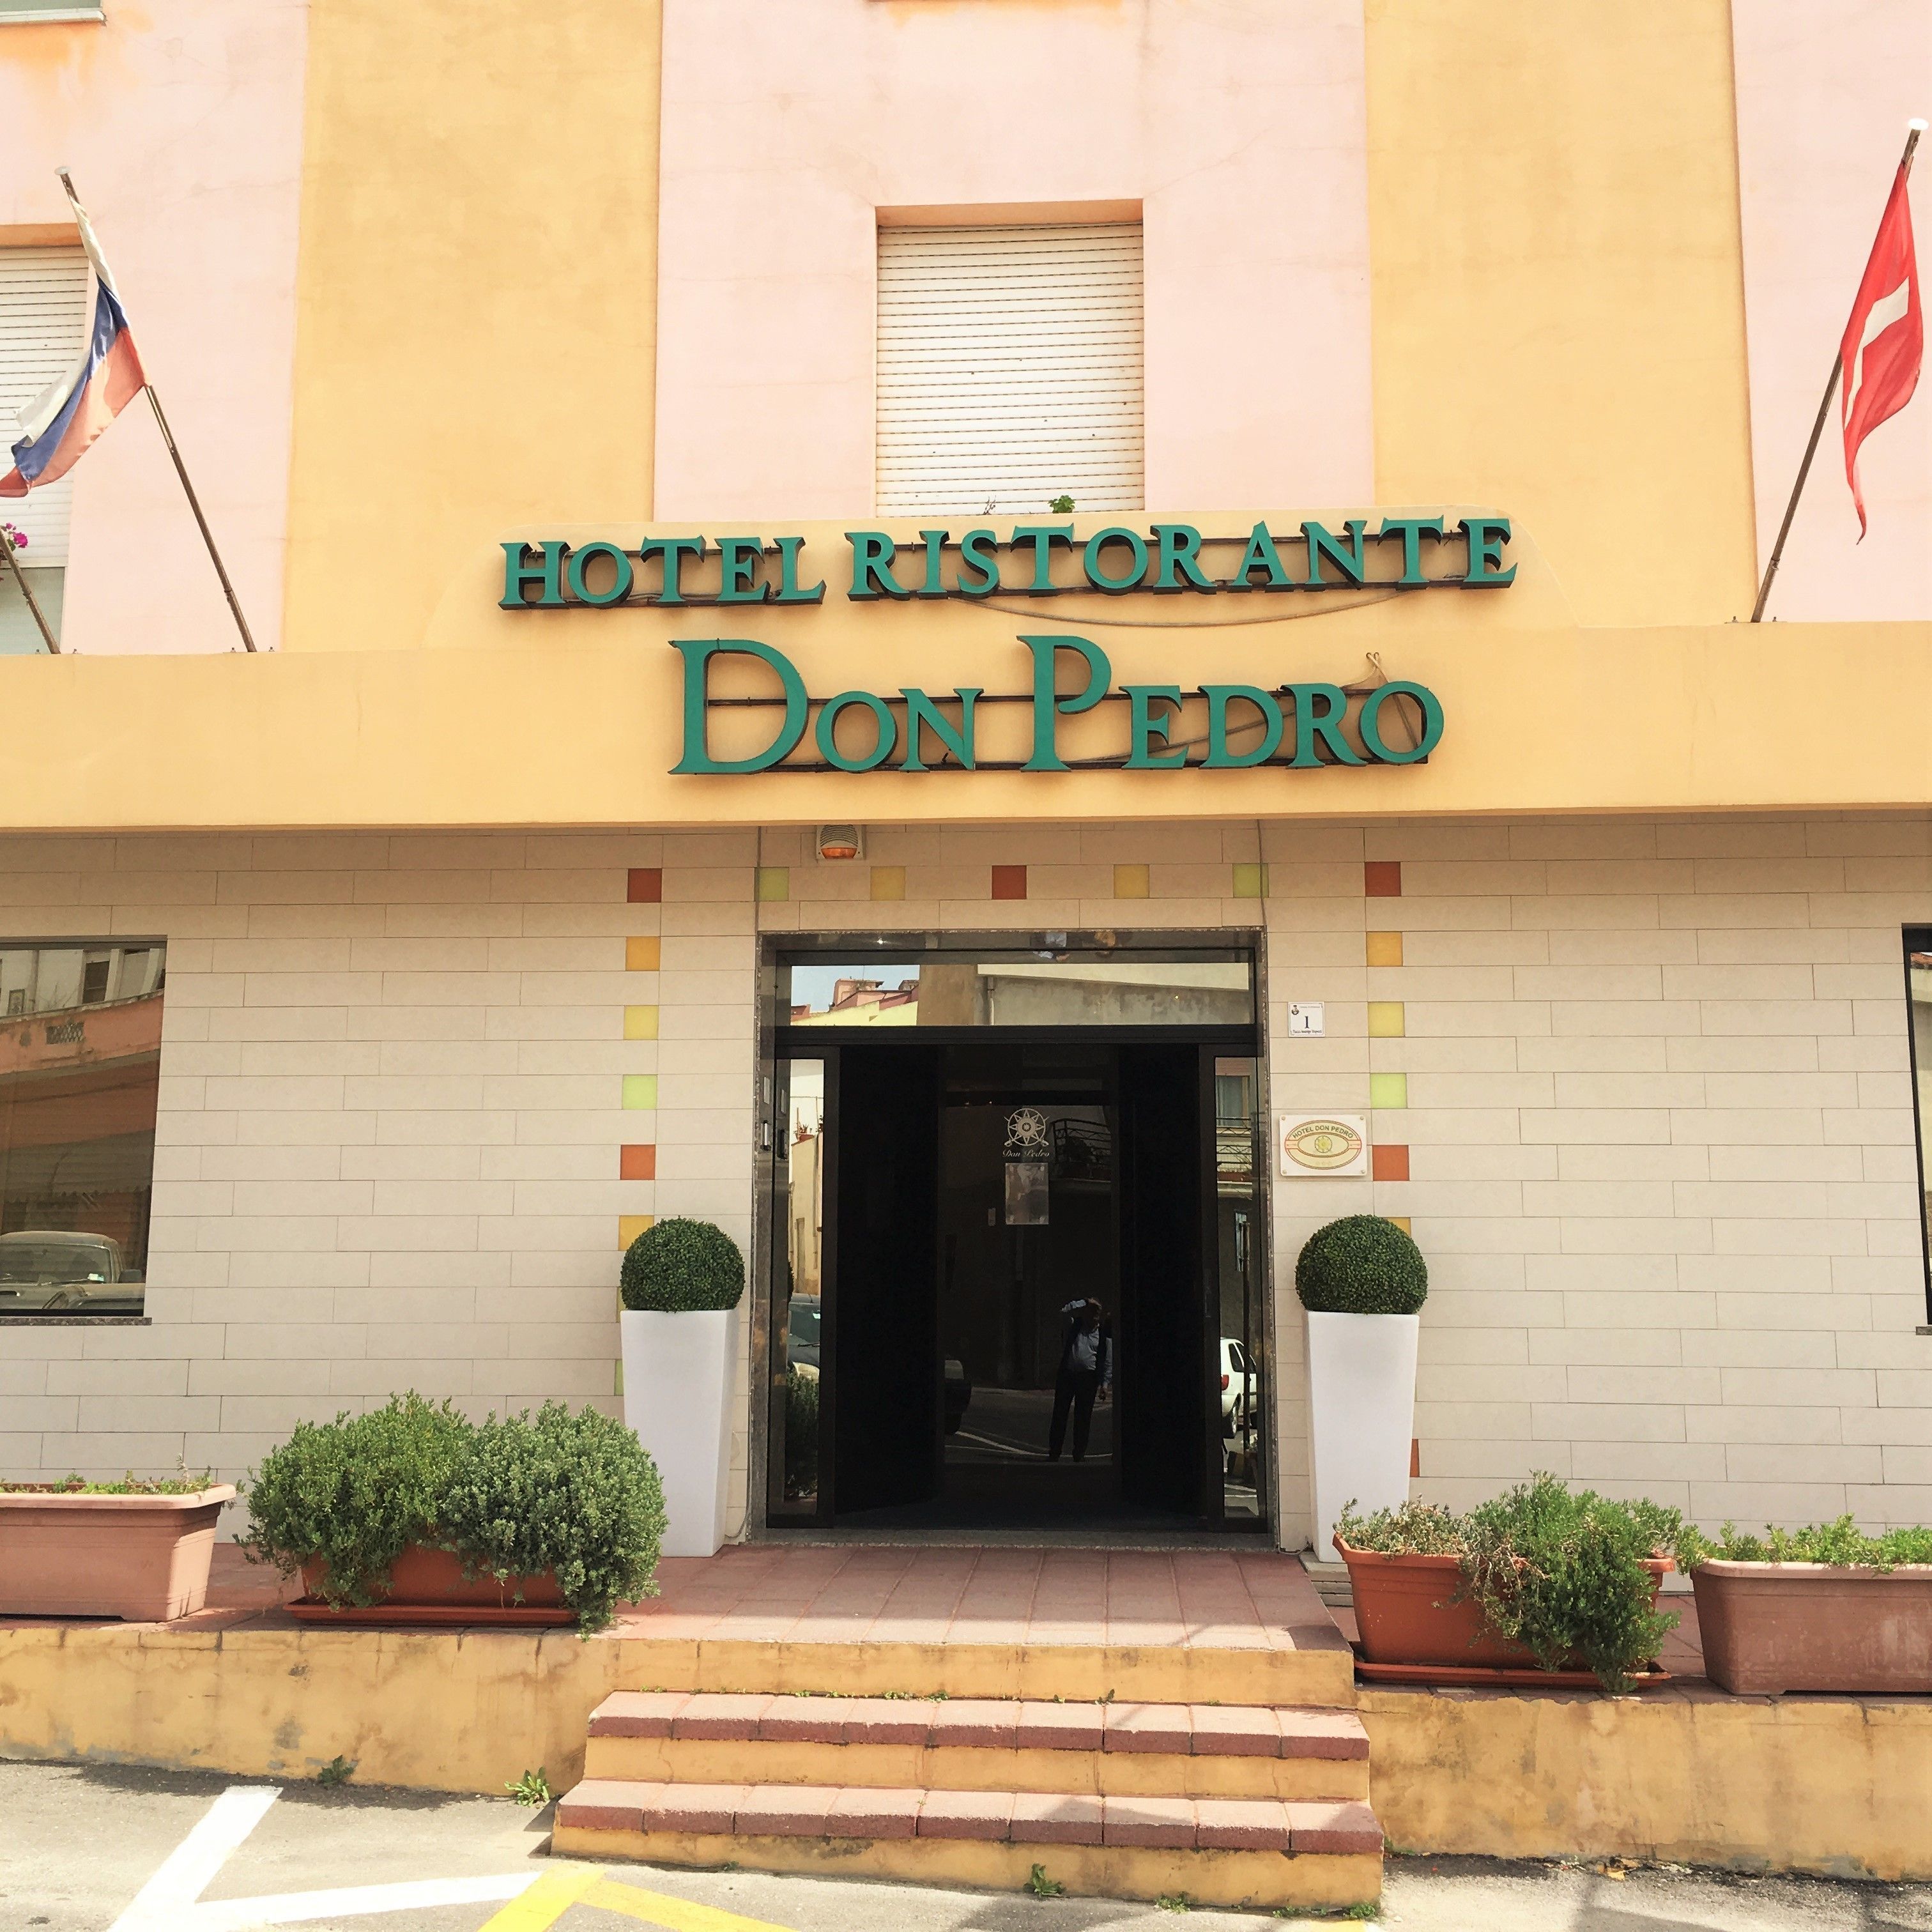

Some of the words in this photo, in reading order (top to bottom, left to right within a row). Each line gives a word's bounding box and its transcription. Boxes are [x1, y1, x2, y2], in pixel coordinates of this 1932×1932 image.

[498, 535, 827, 610] HOTEL
[845, 515, 1518, 602] RISTORANTE
[1292, 1126, 1314, 1138] HOTEL
[1331, 1126, 1354, 1138] PEDRO
